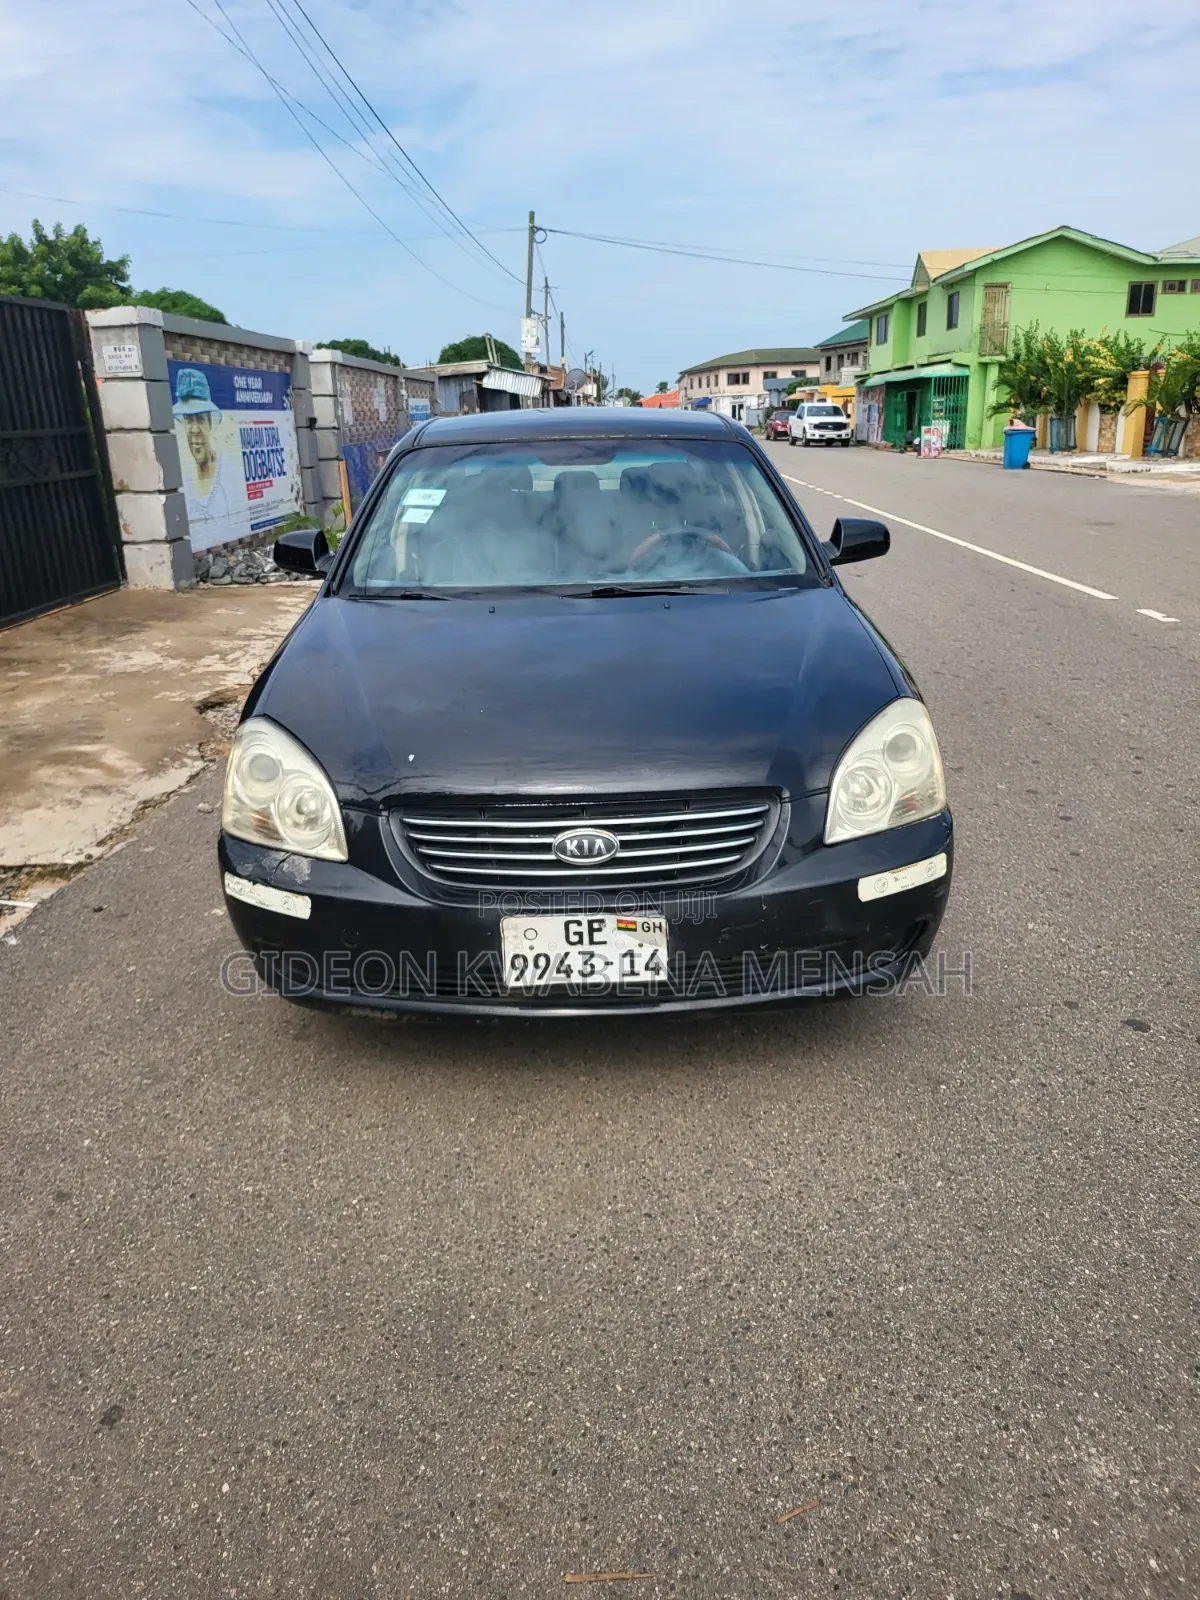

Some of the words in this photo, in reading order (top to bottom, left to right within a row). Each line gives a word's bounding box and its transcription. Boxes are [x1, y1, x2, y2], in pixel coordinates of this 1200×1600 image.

[234, 375, 247, 388] ONE
[247, 377, 263, 390] YEAR
[236, 390, 273, 403] ANNIVERSARY
[239, 427, 265, 449] MADAM
[264, 426, 281, 448] DORA
[242, 447, 287, 482] DOGBATSE
[564, 839, 608, 856] KIA
[564, 918, 608, 946] GE
[641, 921, 663, 933] GH
[510, 948, 662, 982] 9943-14
